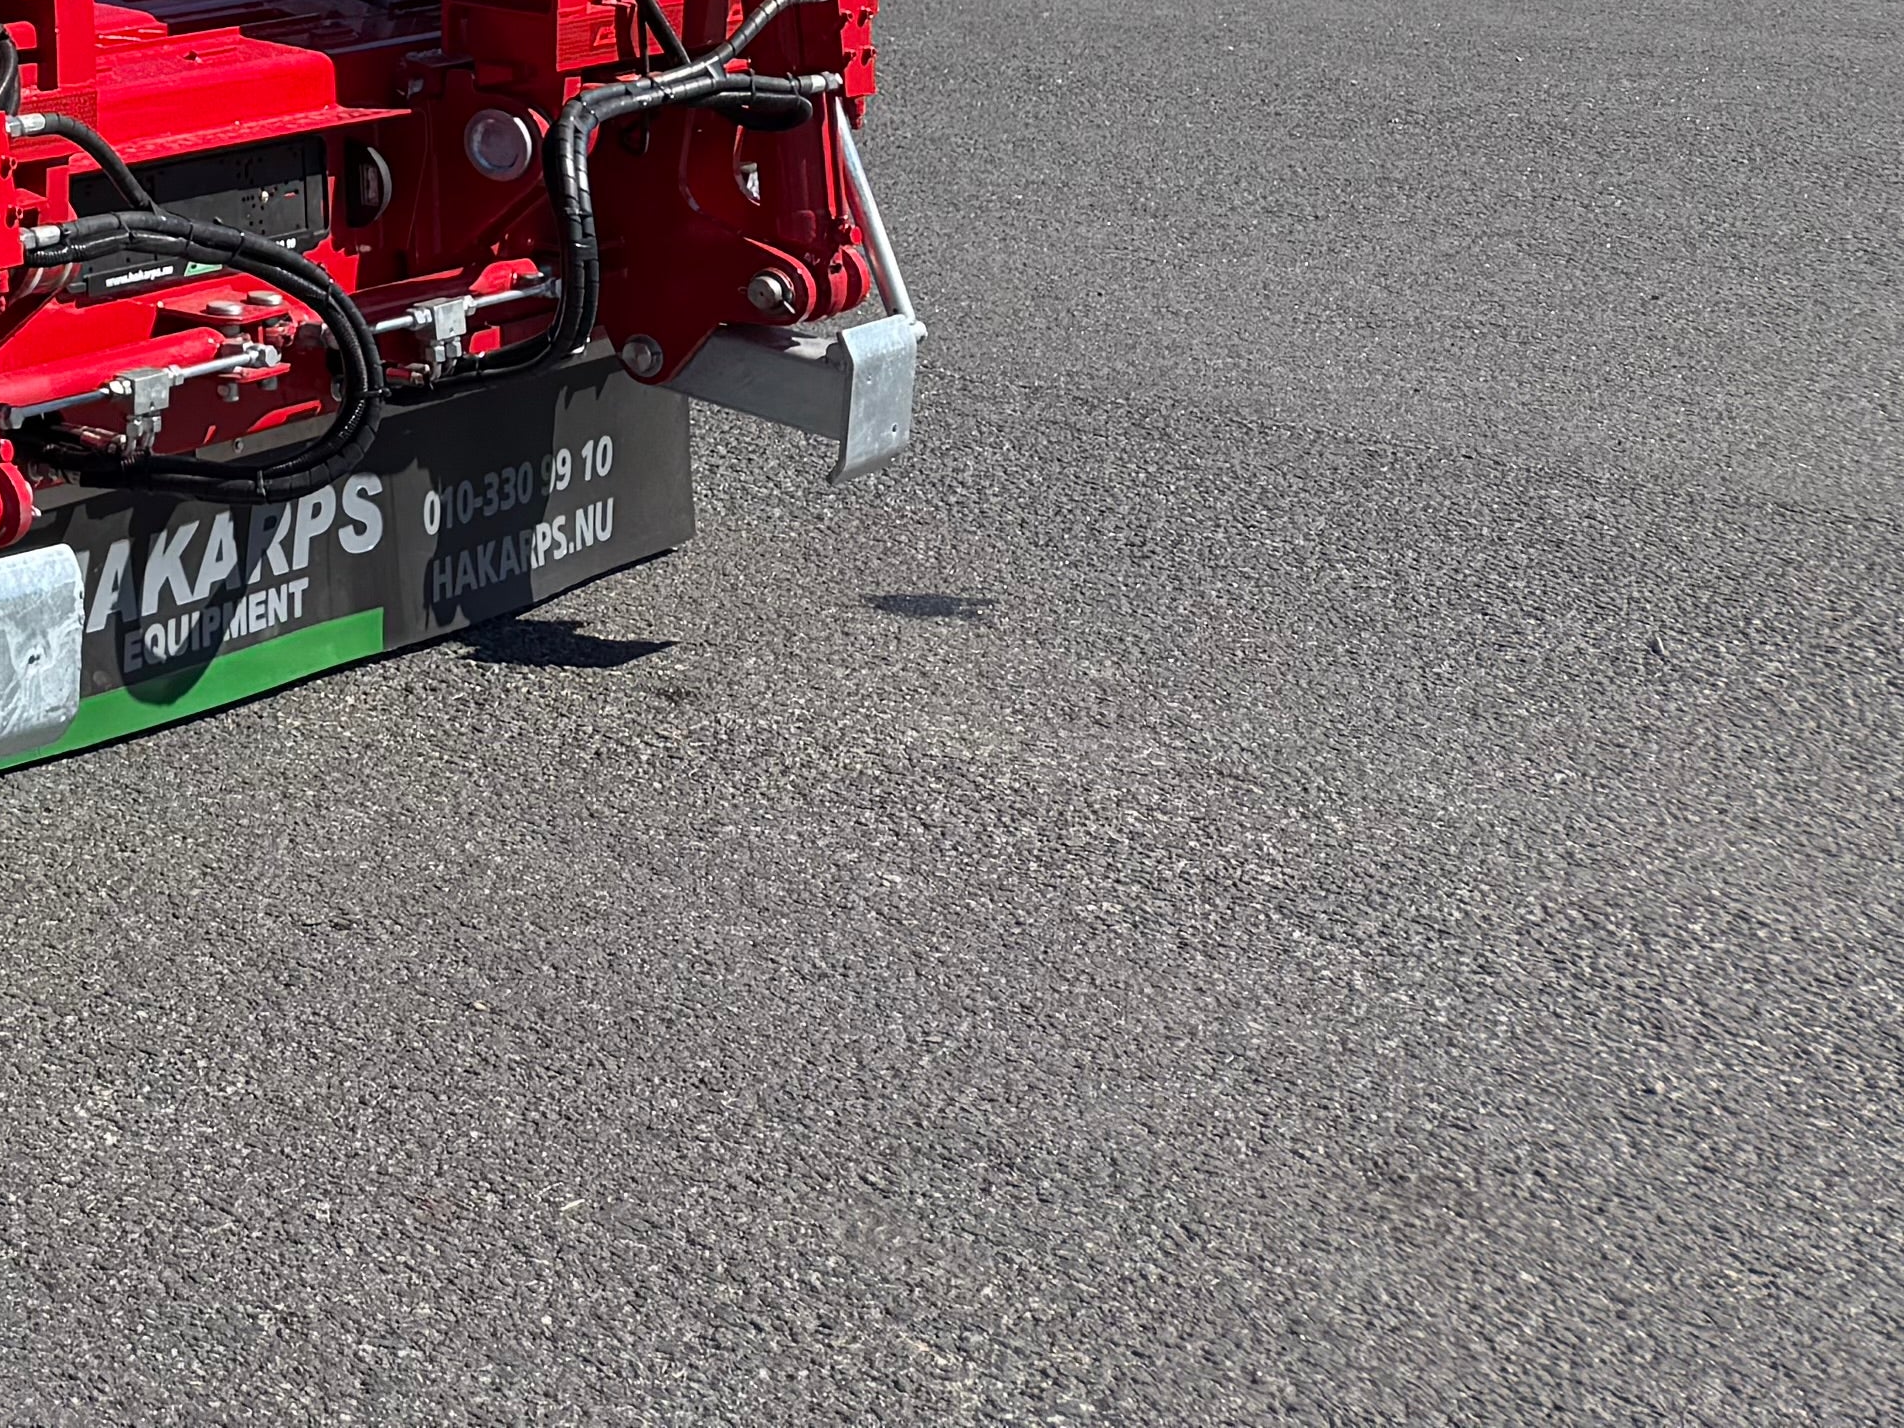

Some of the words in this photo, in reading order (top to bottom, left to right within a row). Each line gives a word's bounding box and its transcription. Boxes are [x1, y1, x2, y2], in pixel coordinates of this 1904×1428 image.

[424, 461, 534, 535] 010-330
[542, 448, 572, 495] 99
[582, 435, 613, 481] 10
[79, 472, 383, 633] AKARPS
[432, 497, 614, 603] HAKARPS.NU
[123, 577, 309, 673] EQUIPMENT
